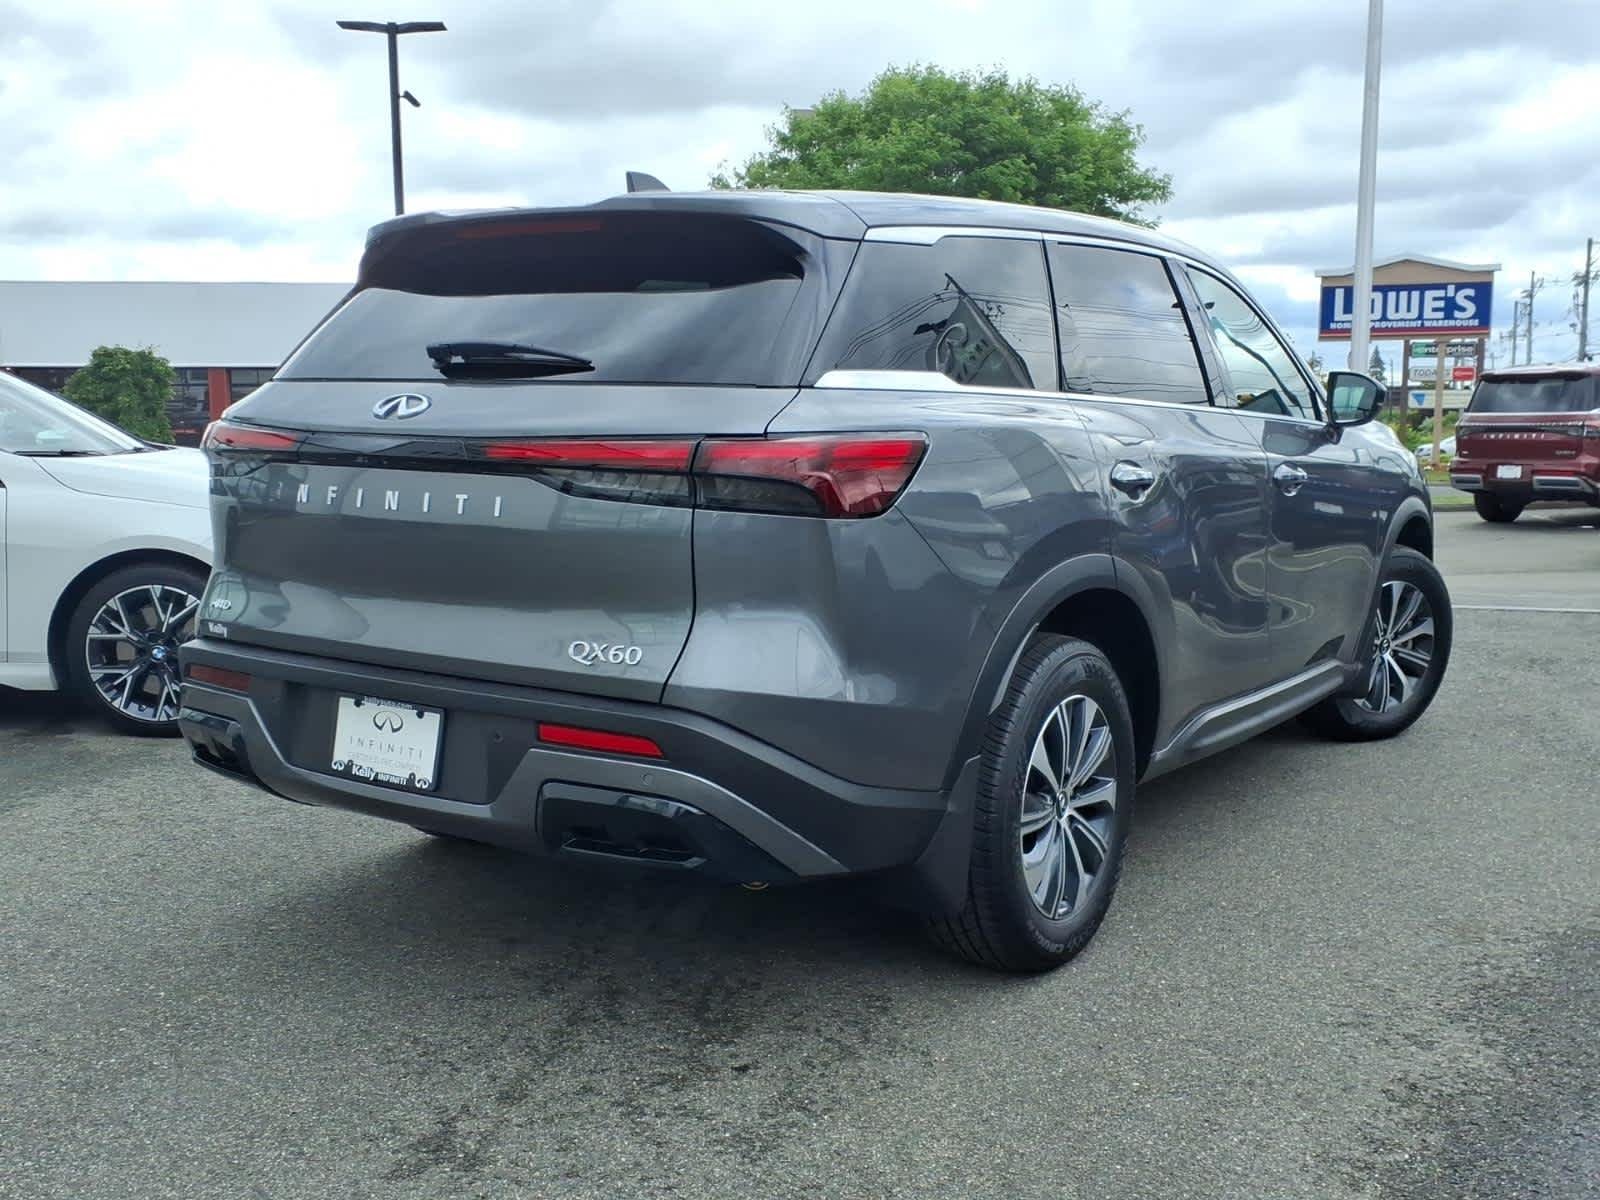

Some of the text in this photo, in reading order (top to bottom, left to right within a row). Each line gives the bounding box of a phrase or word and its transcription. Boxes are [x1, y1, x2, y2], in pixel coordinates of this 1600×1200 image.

[1424, 319, 1479, 327] WAREHOUSE
[277, 481, 501, 517] INFINITI
[568, 641, 643, 665] QX60
[350, 736, 424, 760] INFINITI
[352, 764, 376, 780] Kelly
